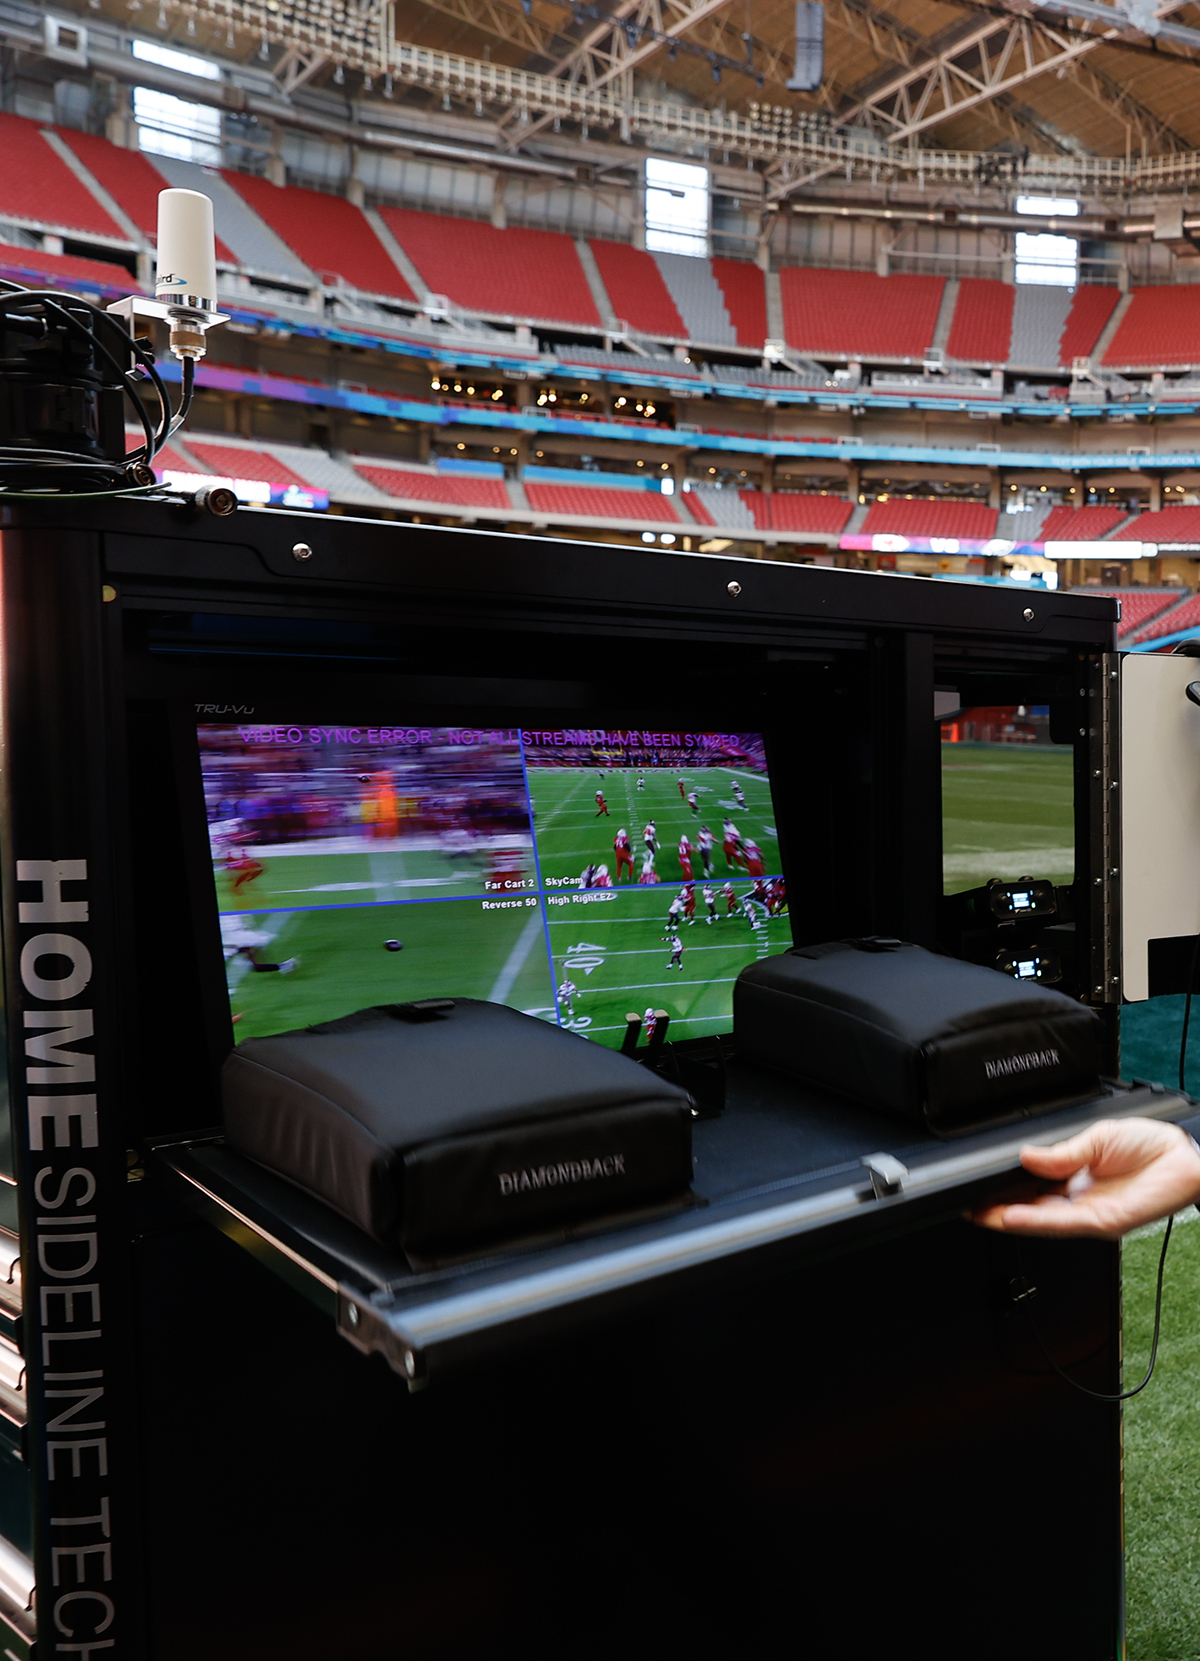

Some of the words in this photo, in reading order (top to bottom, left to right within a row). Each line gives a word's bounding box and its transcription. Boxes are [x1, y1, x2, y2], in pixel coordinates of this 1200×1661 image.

[929, 538, 960, 553] VS
[238, 727, 304, 743] VIDEO
[309, 728, 363, 744] SYNC
[368, 729, 433, 745] ERROR
[449, 731, 484, 745] NOT
[488, 732, 519, 746] ALL
[522, 731, 597, 746] STREAMS
[602, 732, 640, 747] HAVE
[644, 733, 682, 747] BEEN
[684, 734, 740, 748] SYNCED
[485, 881, 502, 890] Far
[505, 880, 526, 889] Cart
[528, 879, 535, 888] 2
[545, 877, 584, 887] SkyCam
[482, 899, 523, 910] Reverse
[525, 898, 537, 907] 50
[547, 896, 570, 906] High
[573, 894, 598, 905] Right
[600, 892, 612, 901] EZ
[16, 858, 99, 1151] HOME
[984, 1048, 1061, 1079] DIAMONDBACK
[498, 1153, 626, 1196] DIAMONDBACK
[34, 1166, 108, 1481] SIDELINE
